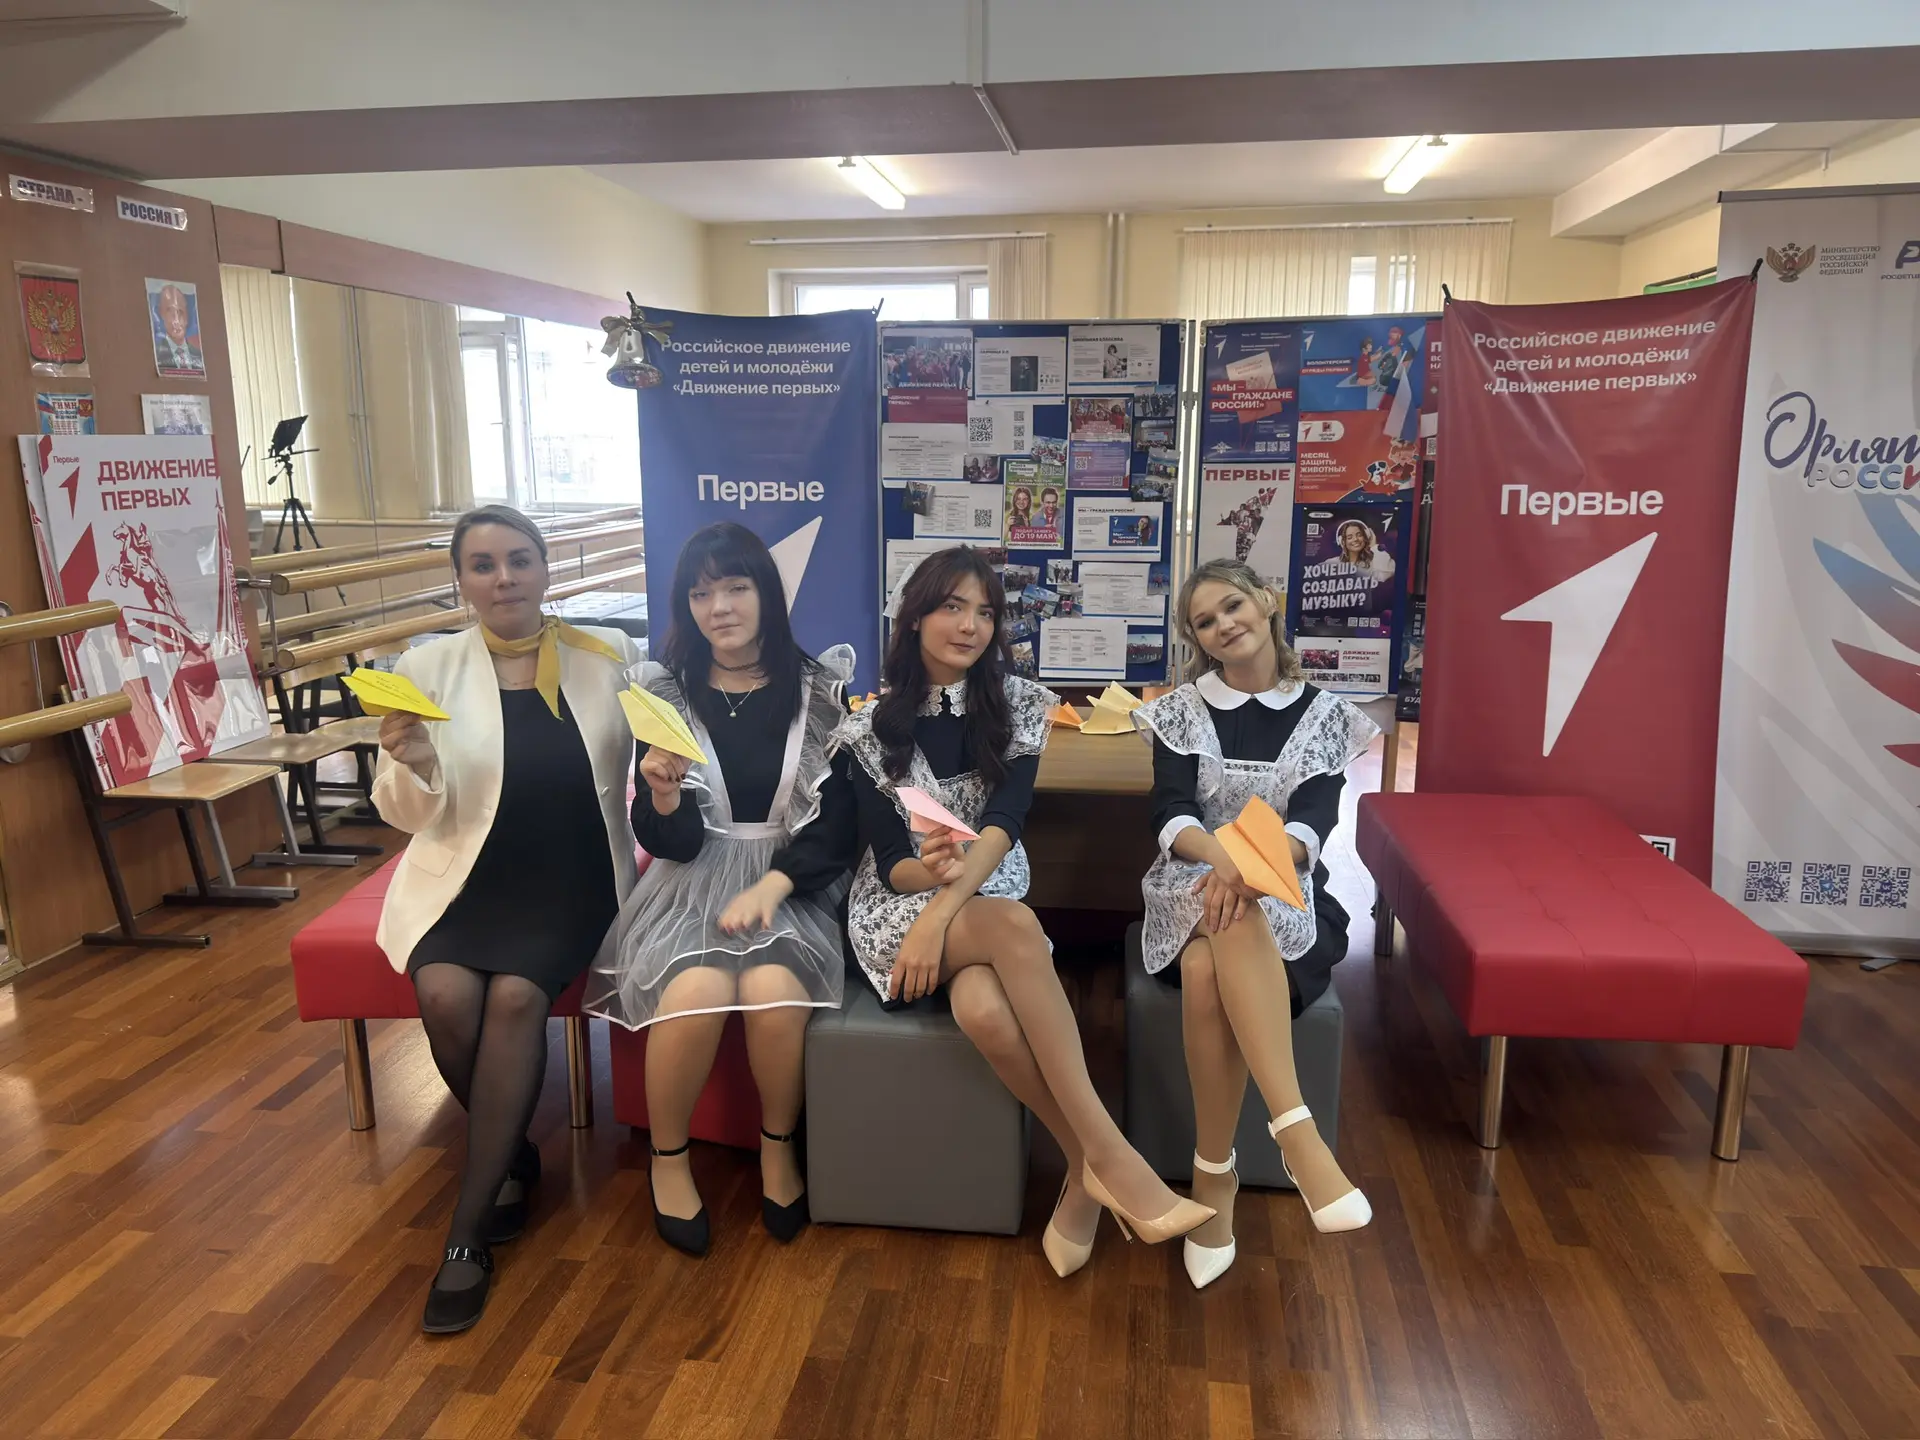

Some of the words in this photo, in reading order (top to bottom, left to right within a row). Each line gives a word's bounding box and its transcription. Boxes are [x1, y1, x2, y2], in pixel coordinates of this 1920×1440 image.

[17, 179, 75, 204] СТРАНА
[1820, 245, 1881, 254] МИНИСТЕРСТВО
[1820, 253, 1877, 261] ПРОСВЕЩЕНИЯ
[1819, 260, 1869, 269] РОССИЙСКОЙ
[1819, 268, 1864, 276] ФЕДЕРАЦИИ
[1474, 330, 1598, 350] Российское
[1602, 320, 1717, 345] движение
[661, 339, 764, 354] Российское
[767, 340, 851, 356] движение
[680, 360, 730, 374] детей
[733, 363, 744, 374] и
[747, 360, 834, 376] молодёжи
[1493, 355, 1553, 372] детей
[1557, 357, 1571, 369] и
[1575, 347, 1690, 368] молодёжи
[673, 379, 769, 395] «Движение
[772, 382, 841, 397] первых»
[1212, 384, 1236, 392] «МЫ
[1484, 376, 1600, 395] «Движение
[1604, 371, 1698, 392] первых»
[1232, 391, 1293, 400] ГРАЖДАНЕ
[1211, 400, 1265, 410] РОССИИ!»
[53, 455, 80, 465] Первые
[97, 458, 217, 486] ДВИЖЕНИЕ
[1205, 469, 1291, 481] ПЕРВЫЕ
[1300, 465, 1347, 473] ЖИВОТНЫХ
[101, 487, 191, 511] ПЕРВЫХ
[697, 474, 825, 510] Первые
[1500, 484, 1664, 525] Первые
[1303, 562, 1357, 579] ХОЧЕШЬ
[1302, 576, 1379, 594] СОЗДАВАТЬ
[1301, 592, 1366, 611] МУЗЫКУ?
